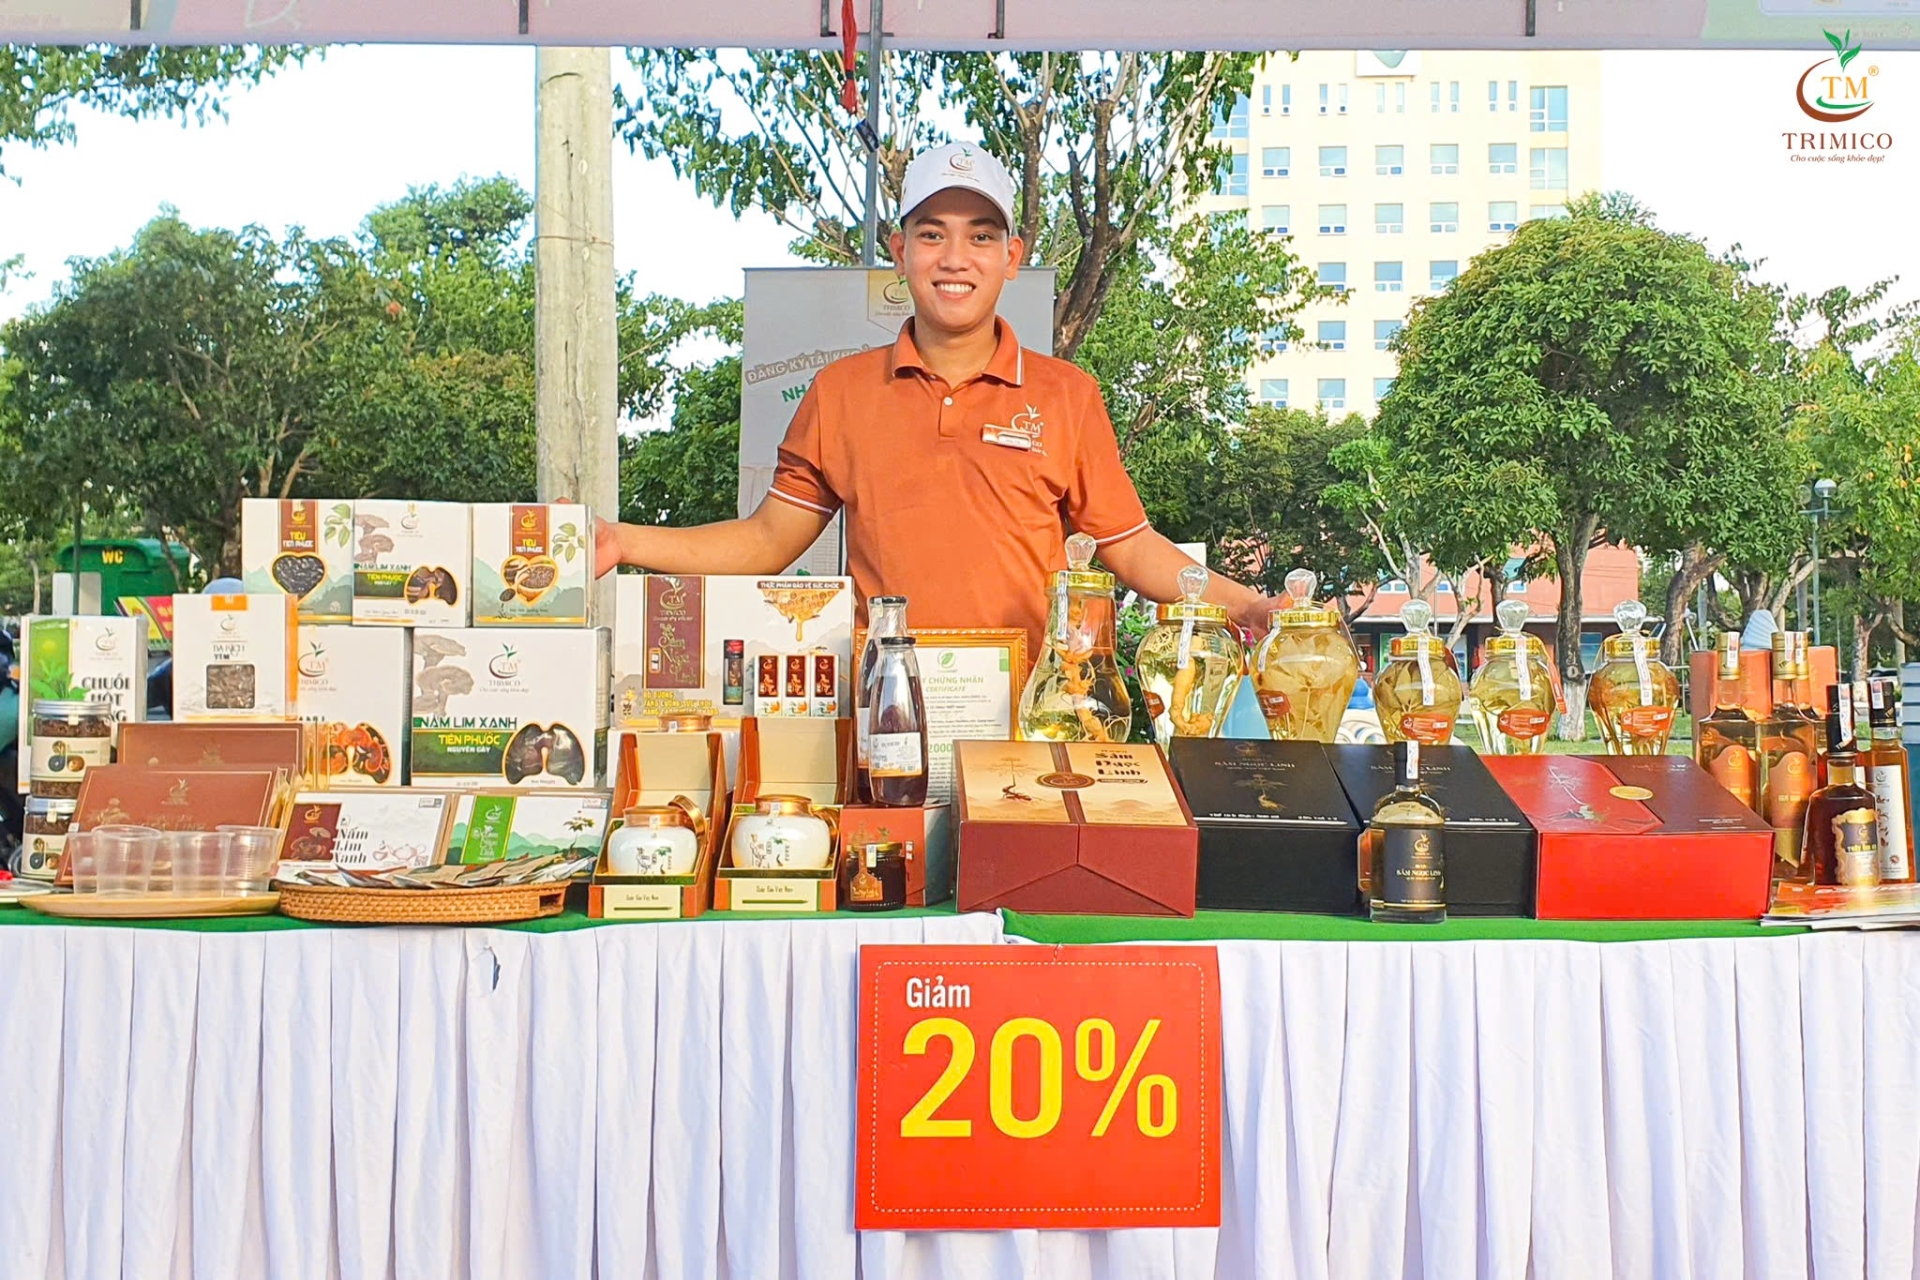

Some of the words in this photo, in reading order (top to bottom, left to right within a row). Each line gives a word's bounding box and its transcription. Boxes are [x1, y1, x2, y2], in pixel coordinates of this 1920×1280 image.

[102, 550, 124, 564] WC
[453, 717, 476, 728] LIM
[479, 717, 518, 729] XANH
[905, 974, 971, 1008] Giảm
[900, 1016, 1178, 1139] 20%
